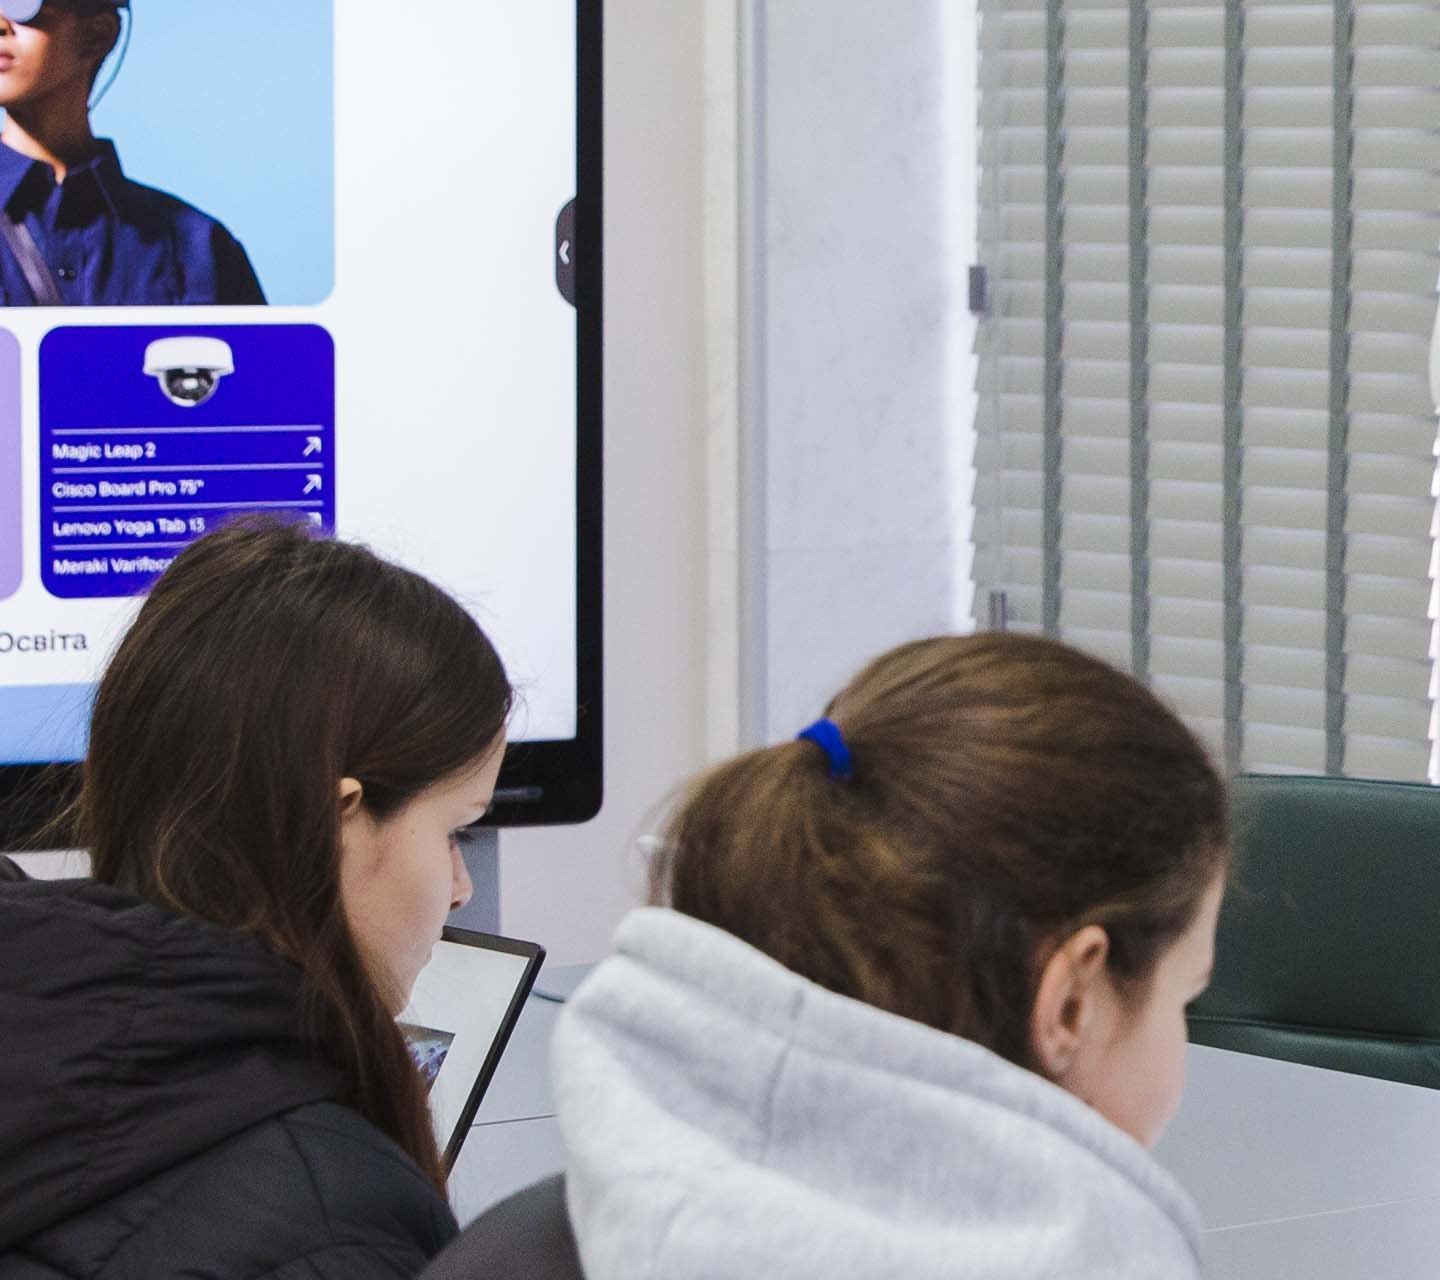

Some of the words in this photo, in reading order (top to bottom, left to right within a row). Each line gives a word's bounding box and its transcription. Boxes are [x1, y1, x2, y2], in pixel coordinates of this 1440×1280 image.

[52, 443, 102, 461] Magic
[104, 442, 144, 460] Leap
[145, 442, 157, 458] 2
[52, 481, 97, 498] Cisco
[99, 481, 146, 497] Board
[148, 480, 177, 496] Pro
[53, 521, 112, 536] Lenovo
[114, 520, 155, 537] Yoga
[157, 518, 187, 534] Tab
[53, 559, 108, 575] Meraki
